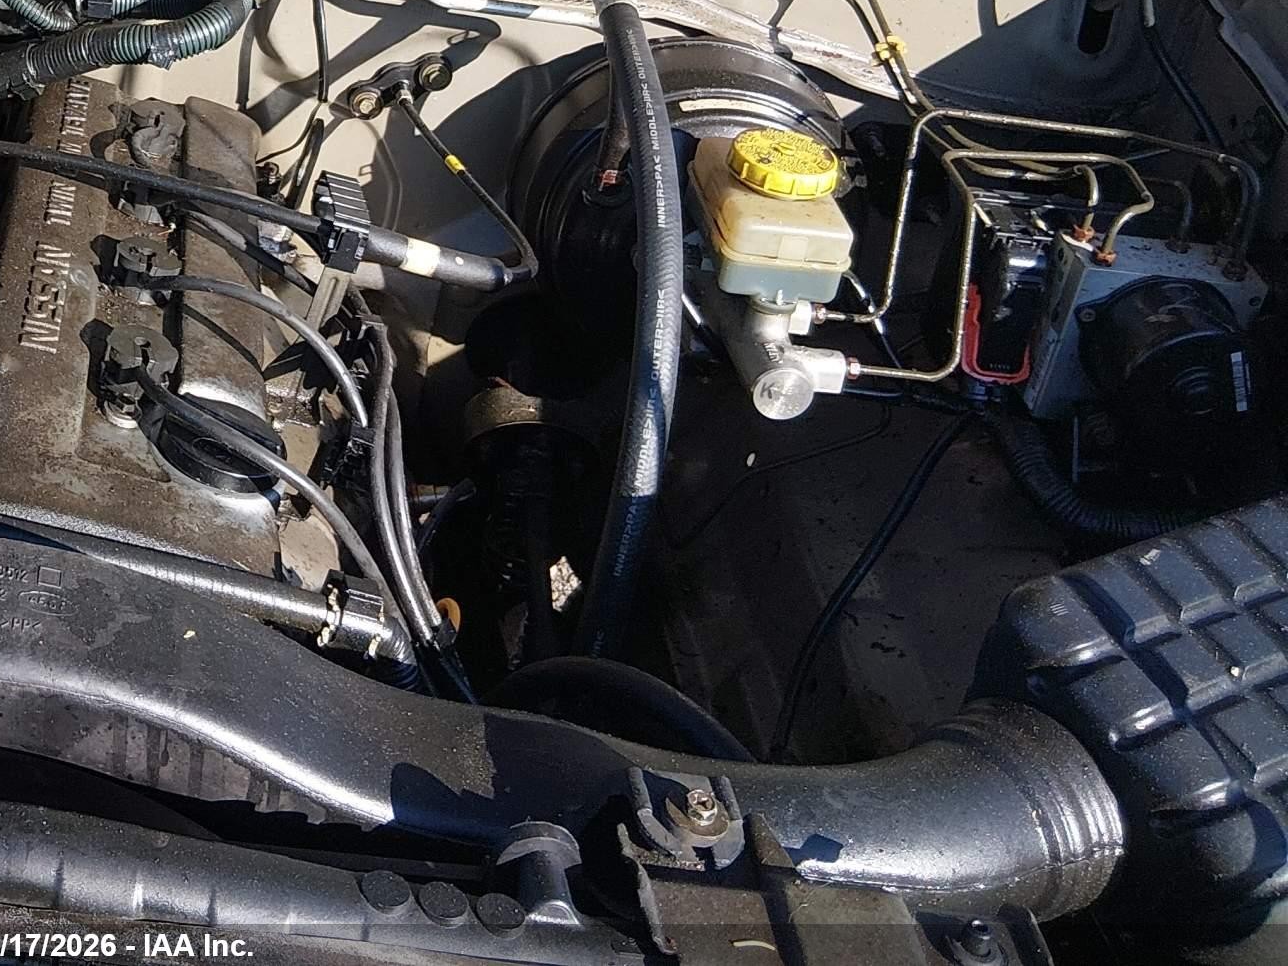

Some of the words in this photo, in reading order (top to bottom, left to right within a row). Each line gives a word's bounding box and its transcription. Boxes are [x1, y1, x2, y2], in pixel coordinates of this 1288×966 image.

[653, 154, 667, 228] INNER>PA<
[18, 241, 72, 354] NISSAN
[759, 382, 774, 399] K
